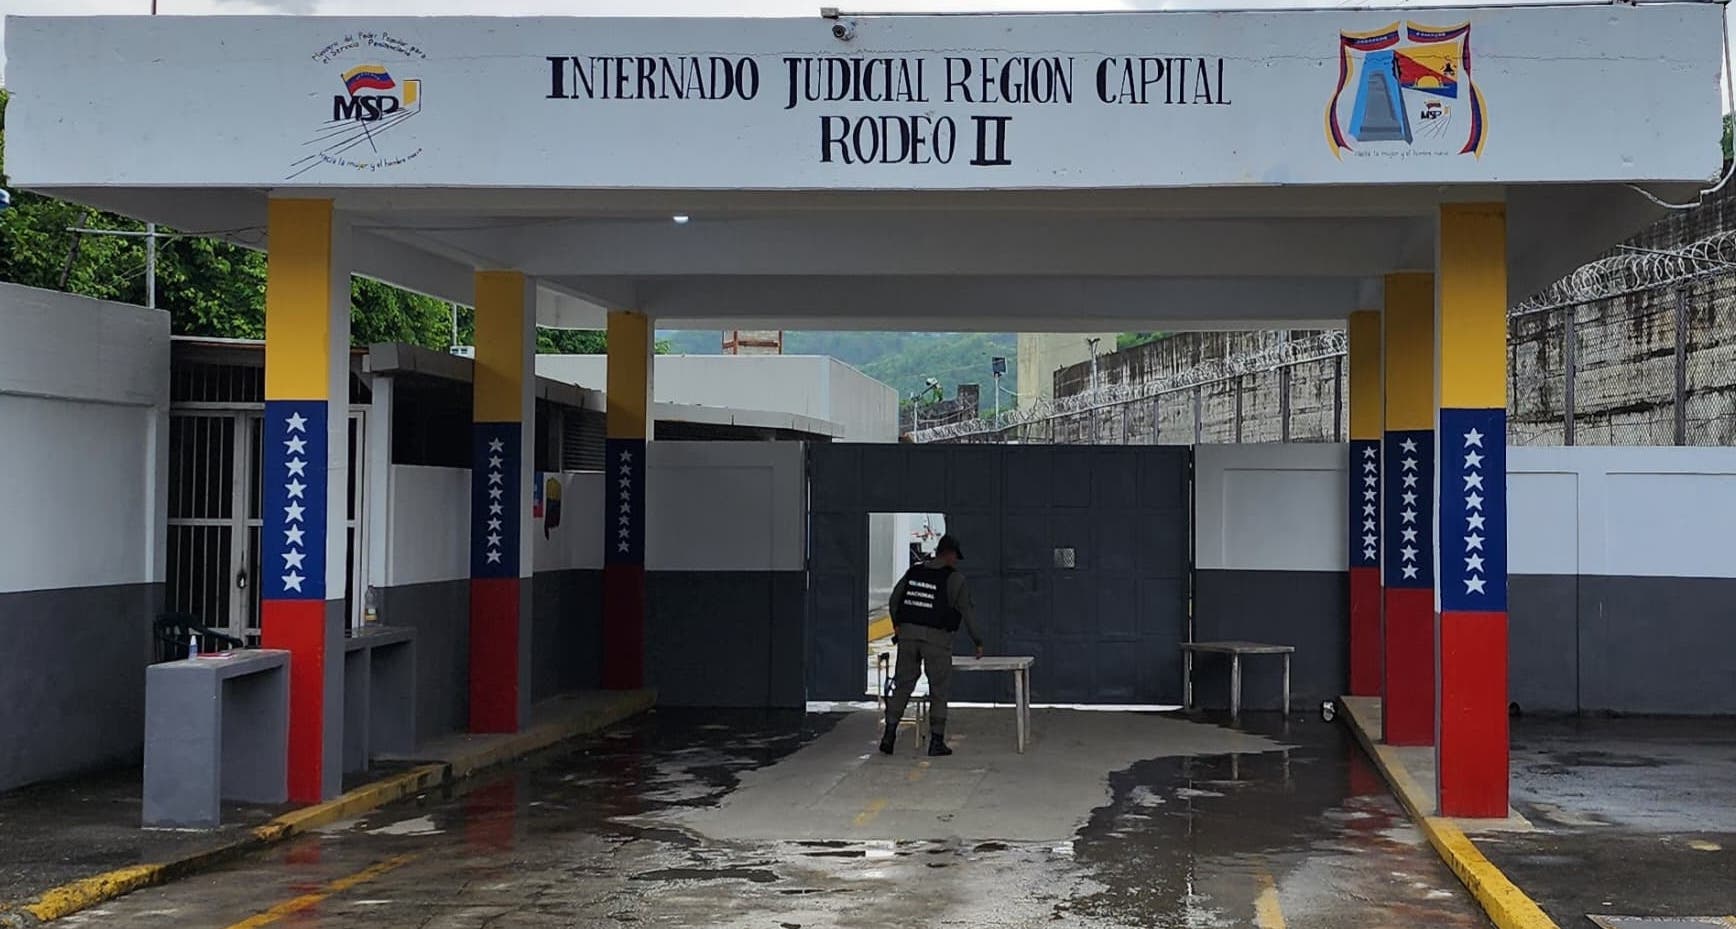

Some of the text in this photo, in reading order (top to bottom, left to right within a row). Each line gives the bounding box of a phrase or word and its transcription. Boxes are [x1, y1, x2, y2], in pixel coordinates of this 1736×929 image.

[546, 56, 1232, 109] INTERNADO JUDICIAL REGION CAPITAL
[334, 95, 399, 121] MSP
[1421, 110, 1442, 120] MSP
[819, 115, 1013, 166] RODEO II
